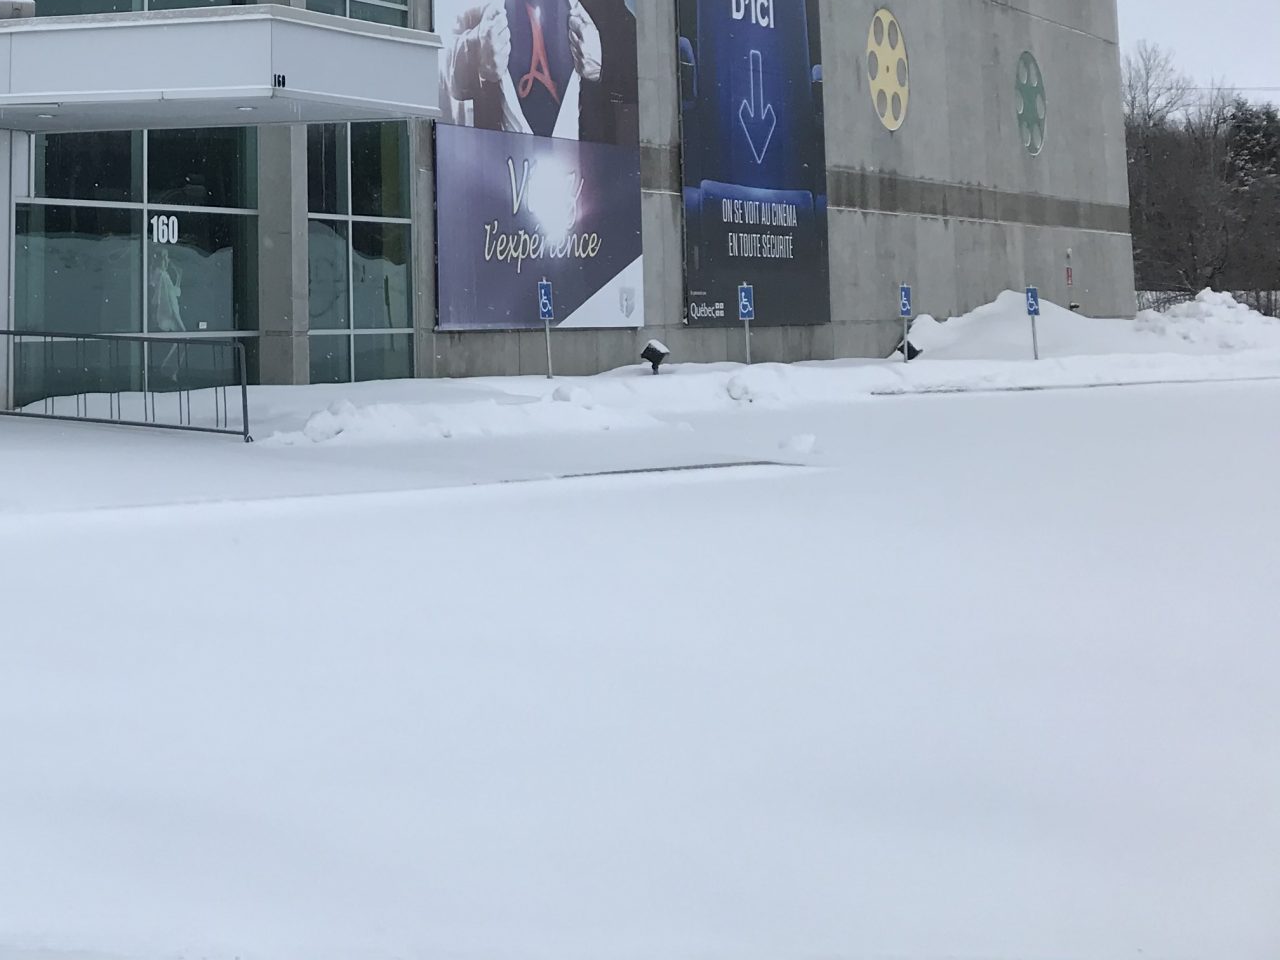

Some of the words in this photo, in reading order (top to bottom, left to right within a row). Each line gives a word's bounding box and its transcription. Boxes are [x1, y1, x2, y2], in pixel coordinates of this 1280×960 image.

[273, 73, 286, 88] 160
[722, 197, 733, 224] ON
[733, 199, 744, 224] SE
[743, 200, 760, 225] VOIT
[761, 202, 771, 226] AU
[771, 200, 798, 227] CINÉMA
[150, 215, 179, 244] 160
[728, 232, 739, 257] EN
[739, 233, 761, 258] TOUTE
[761, 230, 794, 259] SÉCURITÉ
[690, 302, 717, 320] Québec
